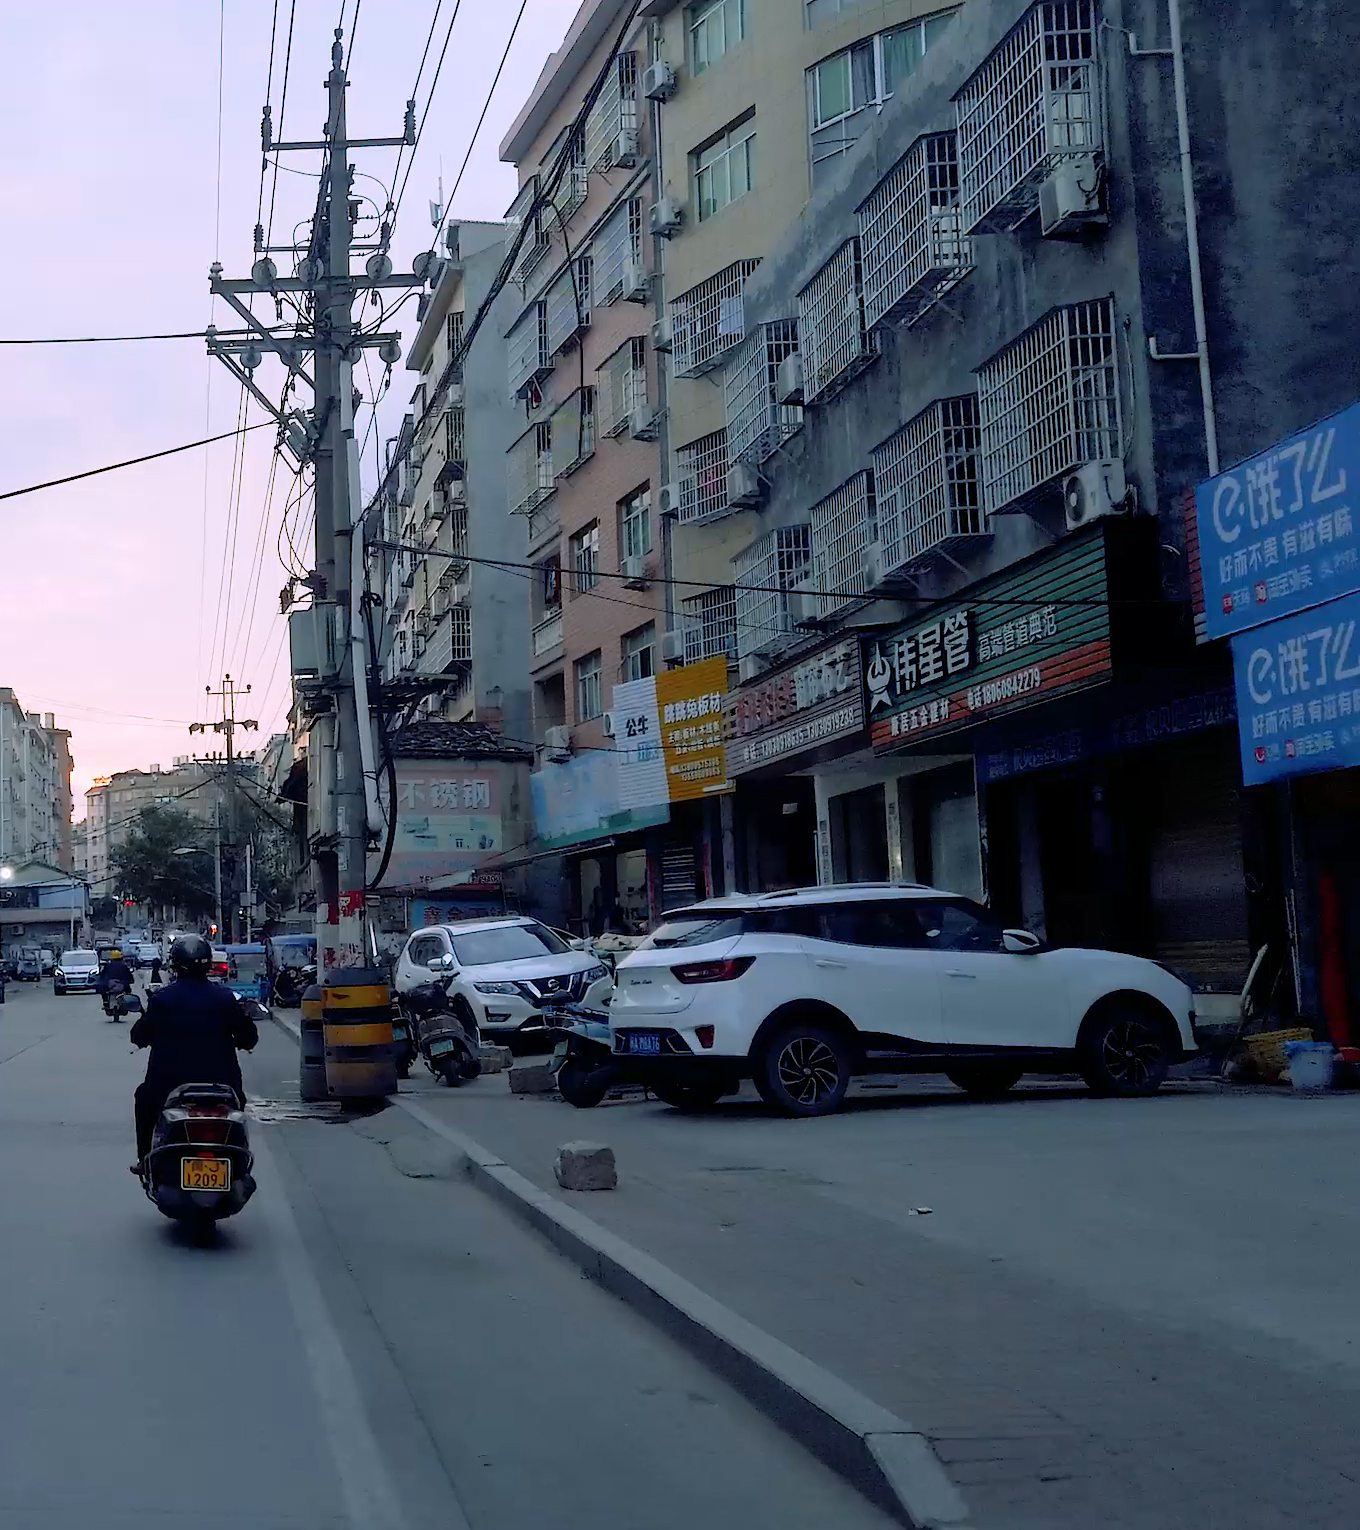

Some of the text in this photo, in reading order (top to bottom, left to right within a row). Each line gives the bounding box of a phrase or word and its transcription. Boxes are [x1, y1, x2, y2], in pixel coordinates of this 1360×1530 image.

[1246, 428, 1346, 529] 饿了么
[1220, 536, 1279, 585] 好而不贵
[1282, 506, 1353, 559] 有滋有味
[894, 610, 970, 695] 伟星管
[978, 603, 1058, 663] 高端管道典范
[1278, 618, 1360, 696] 饿了么
[626, 715, 648, 737] 公牛
[1252, 703, 1306, 740] 好而不贵
